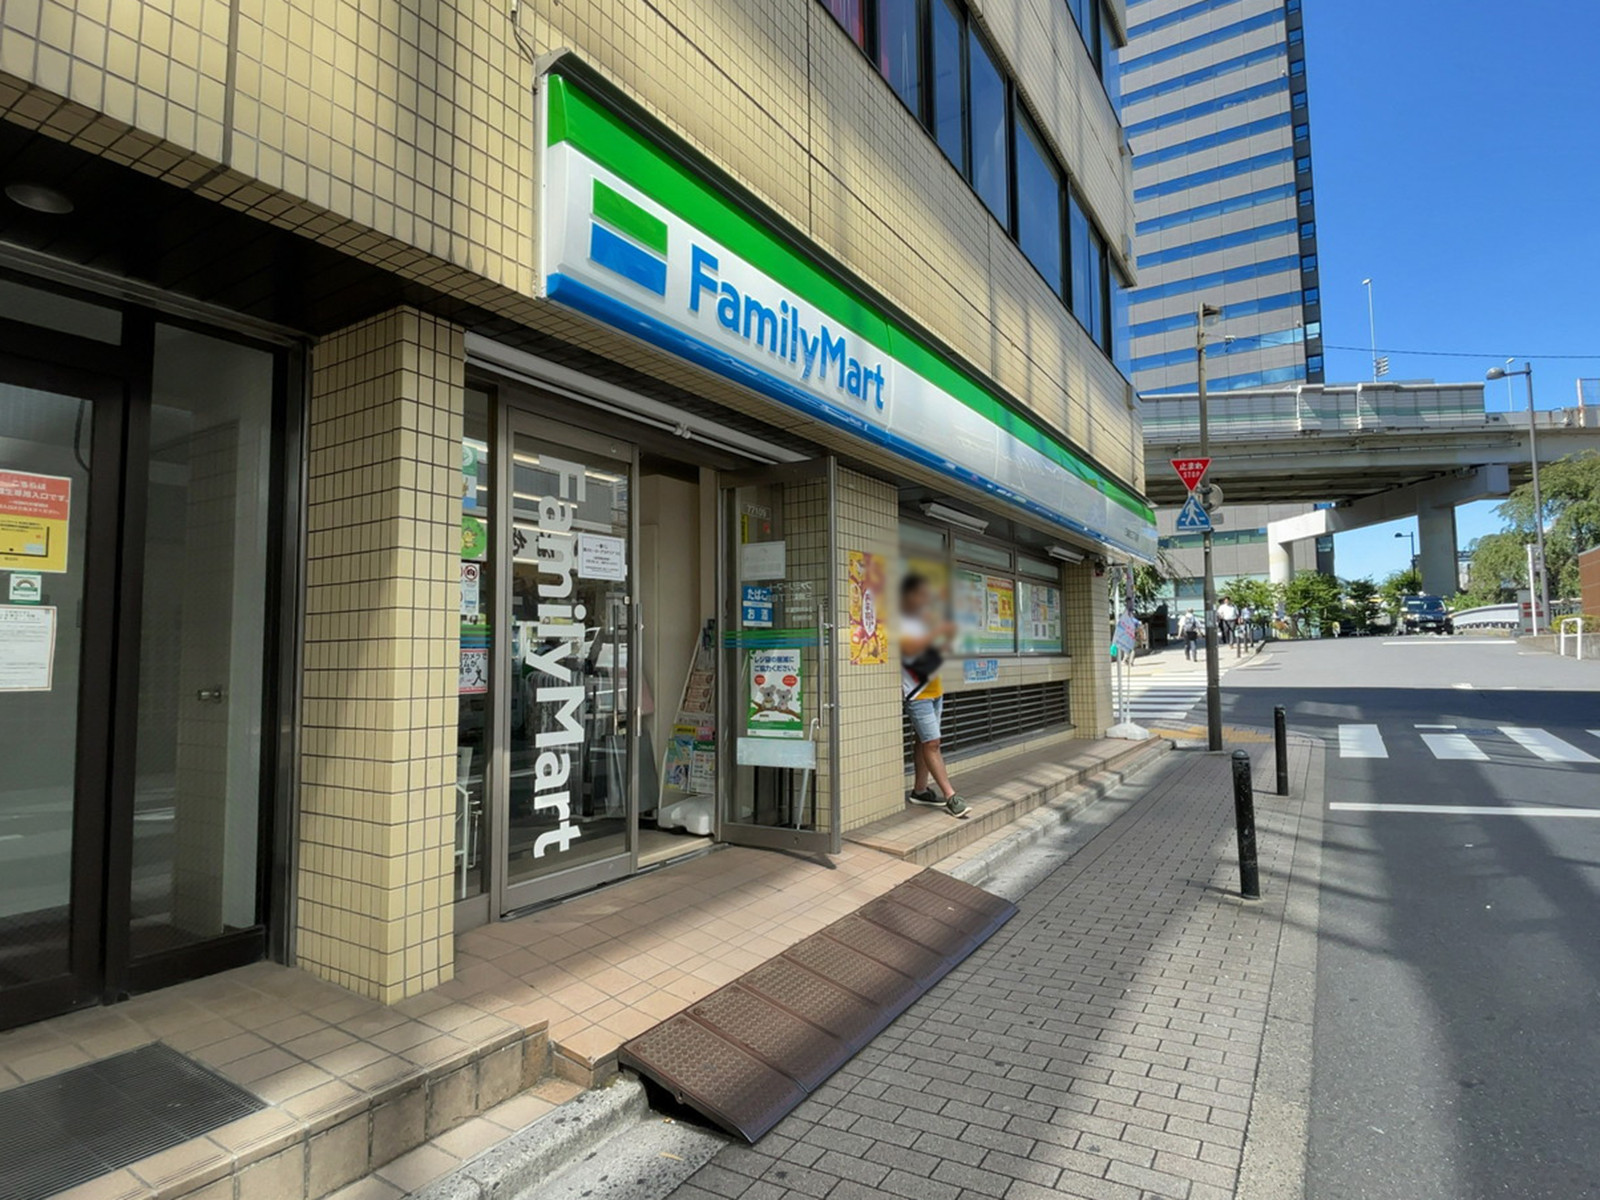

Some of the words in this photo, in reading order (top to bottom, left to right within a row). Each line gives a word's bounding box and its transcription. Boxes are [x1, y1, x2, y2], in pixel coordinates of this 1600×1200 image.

[688, 242, 885, 410] FamilyMart
[1178, 462, 1204, 471] 止まれ
[1183, 471, 1201, 479] STOP
[747, 588, 768, 601] たばこ
[460, 652, 487, 661] カメラで
[525, 454, 586, 859] FamilyMart
